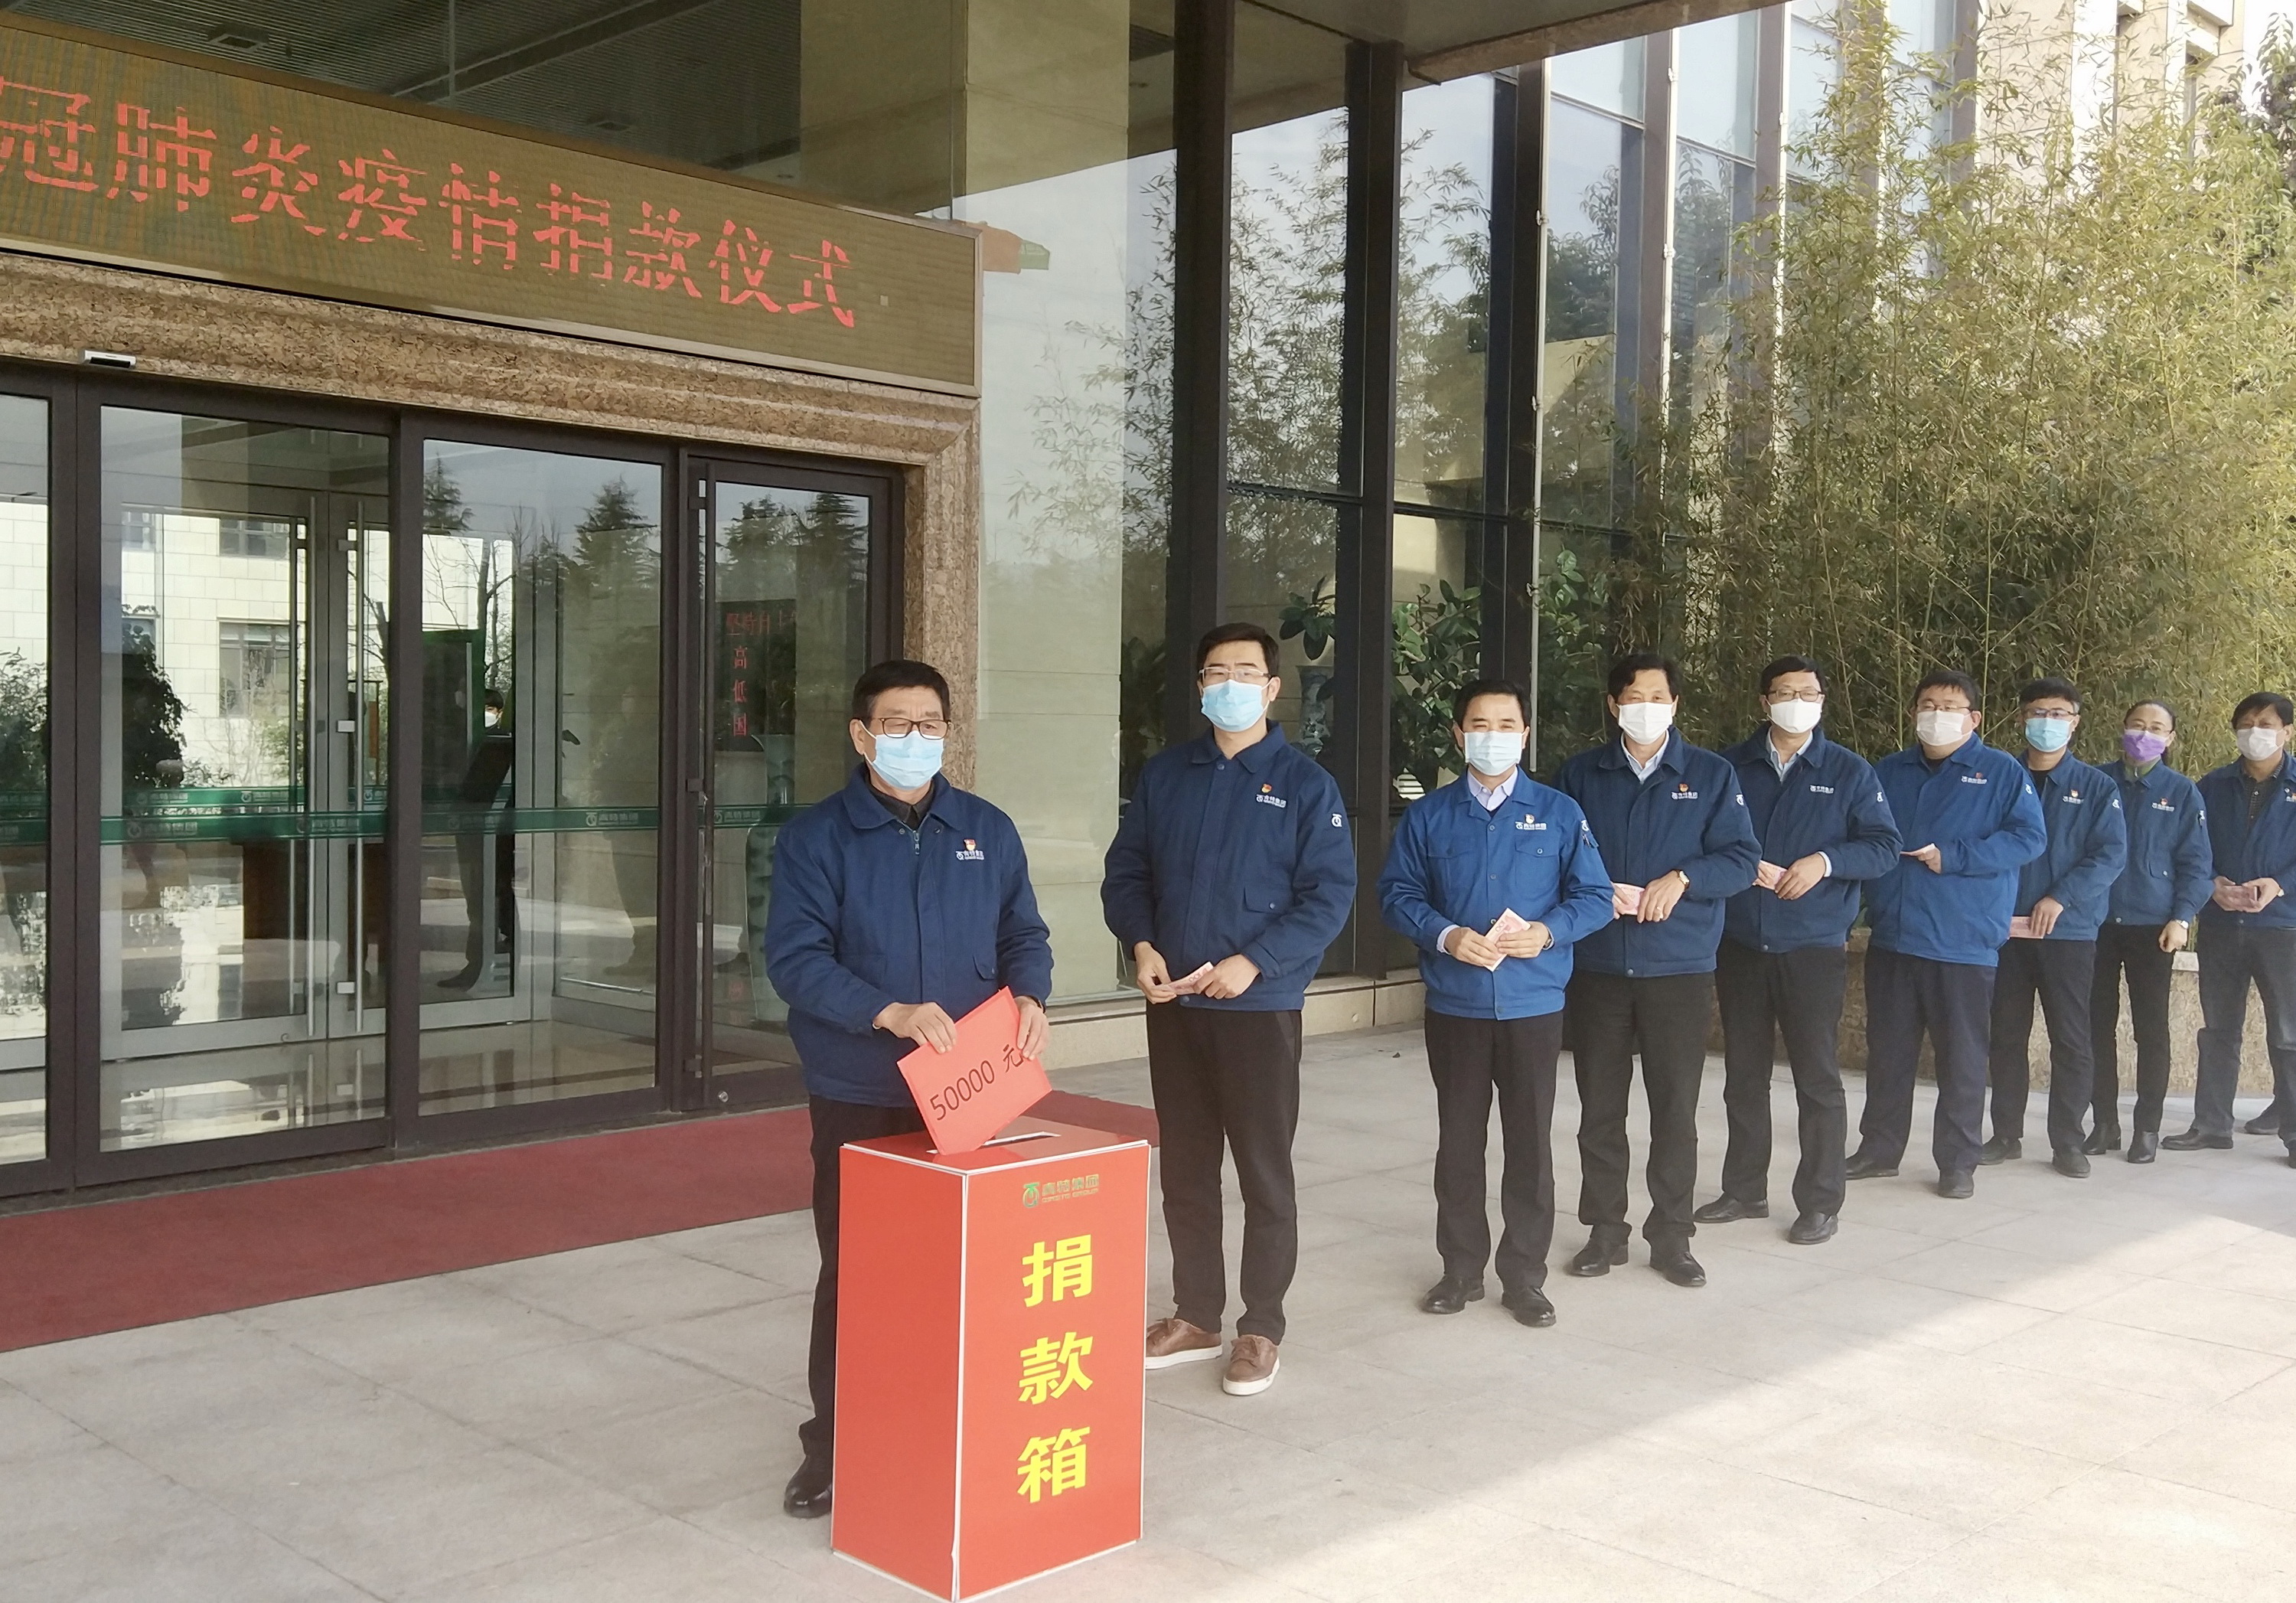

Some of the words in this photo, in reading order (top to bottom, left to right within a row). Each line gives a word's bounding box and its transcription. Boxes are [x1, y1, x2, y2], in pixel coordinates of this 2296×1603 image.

[928, 1044, 995, 1121] 50000
[1002, 1043, 1024, 1073] 元
[1016, 1233, 1094, 1503] 捐款箱
